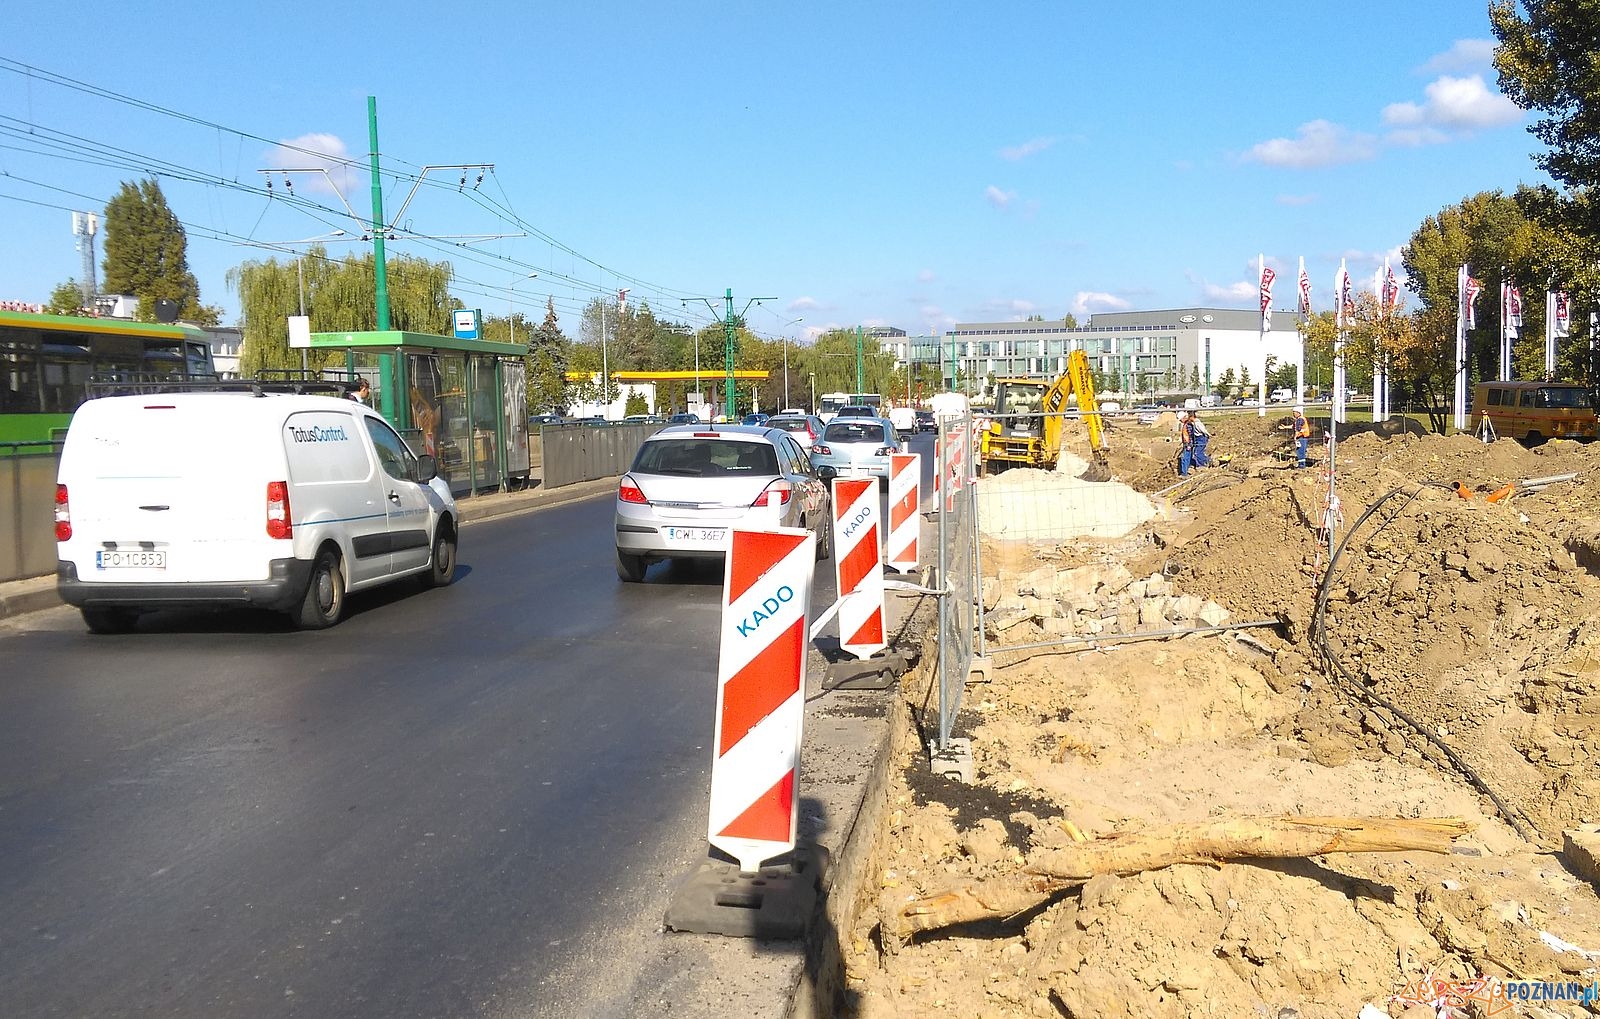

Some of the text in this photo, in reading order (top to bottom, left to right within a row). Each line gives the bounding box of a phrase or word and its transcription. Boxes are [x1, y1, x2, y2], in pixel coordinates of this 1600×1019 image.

[843, 506, 871, 538] KADO
[675, 529, 727, 542] CWL 36E7
[103, 553, 163, 566] PO 1C853
[737, 586, 793, 637] KADO
